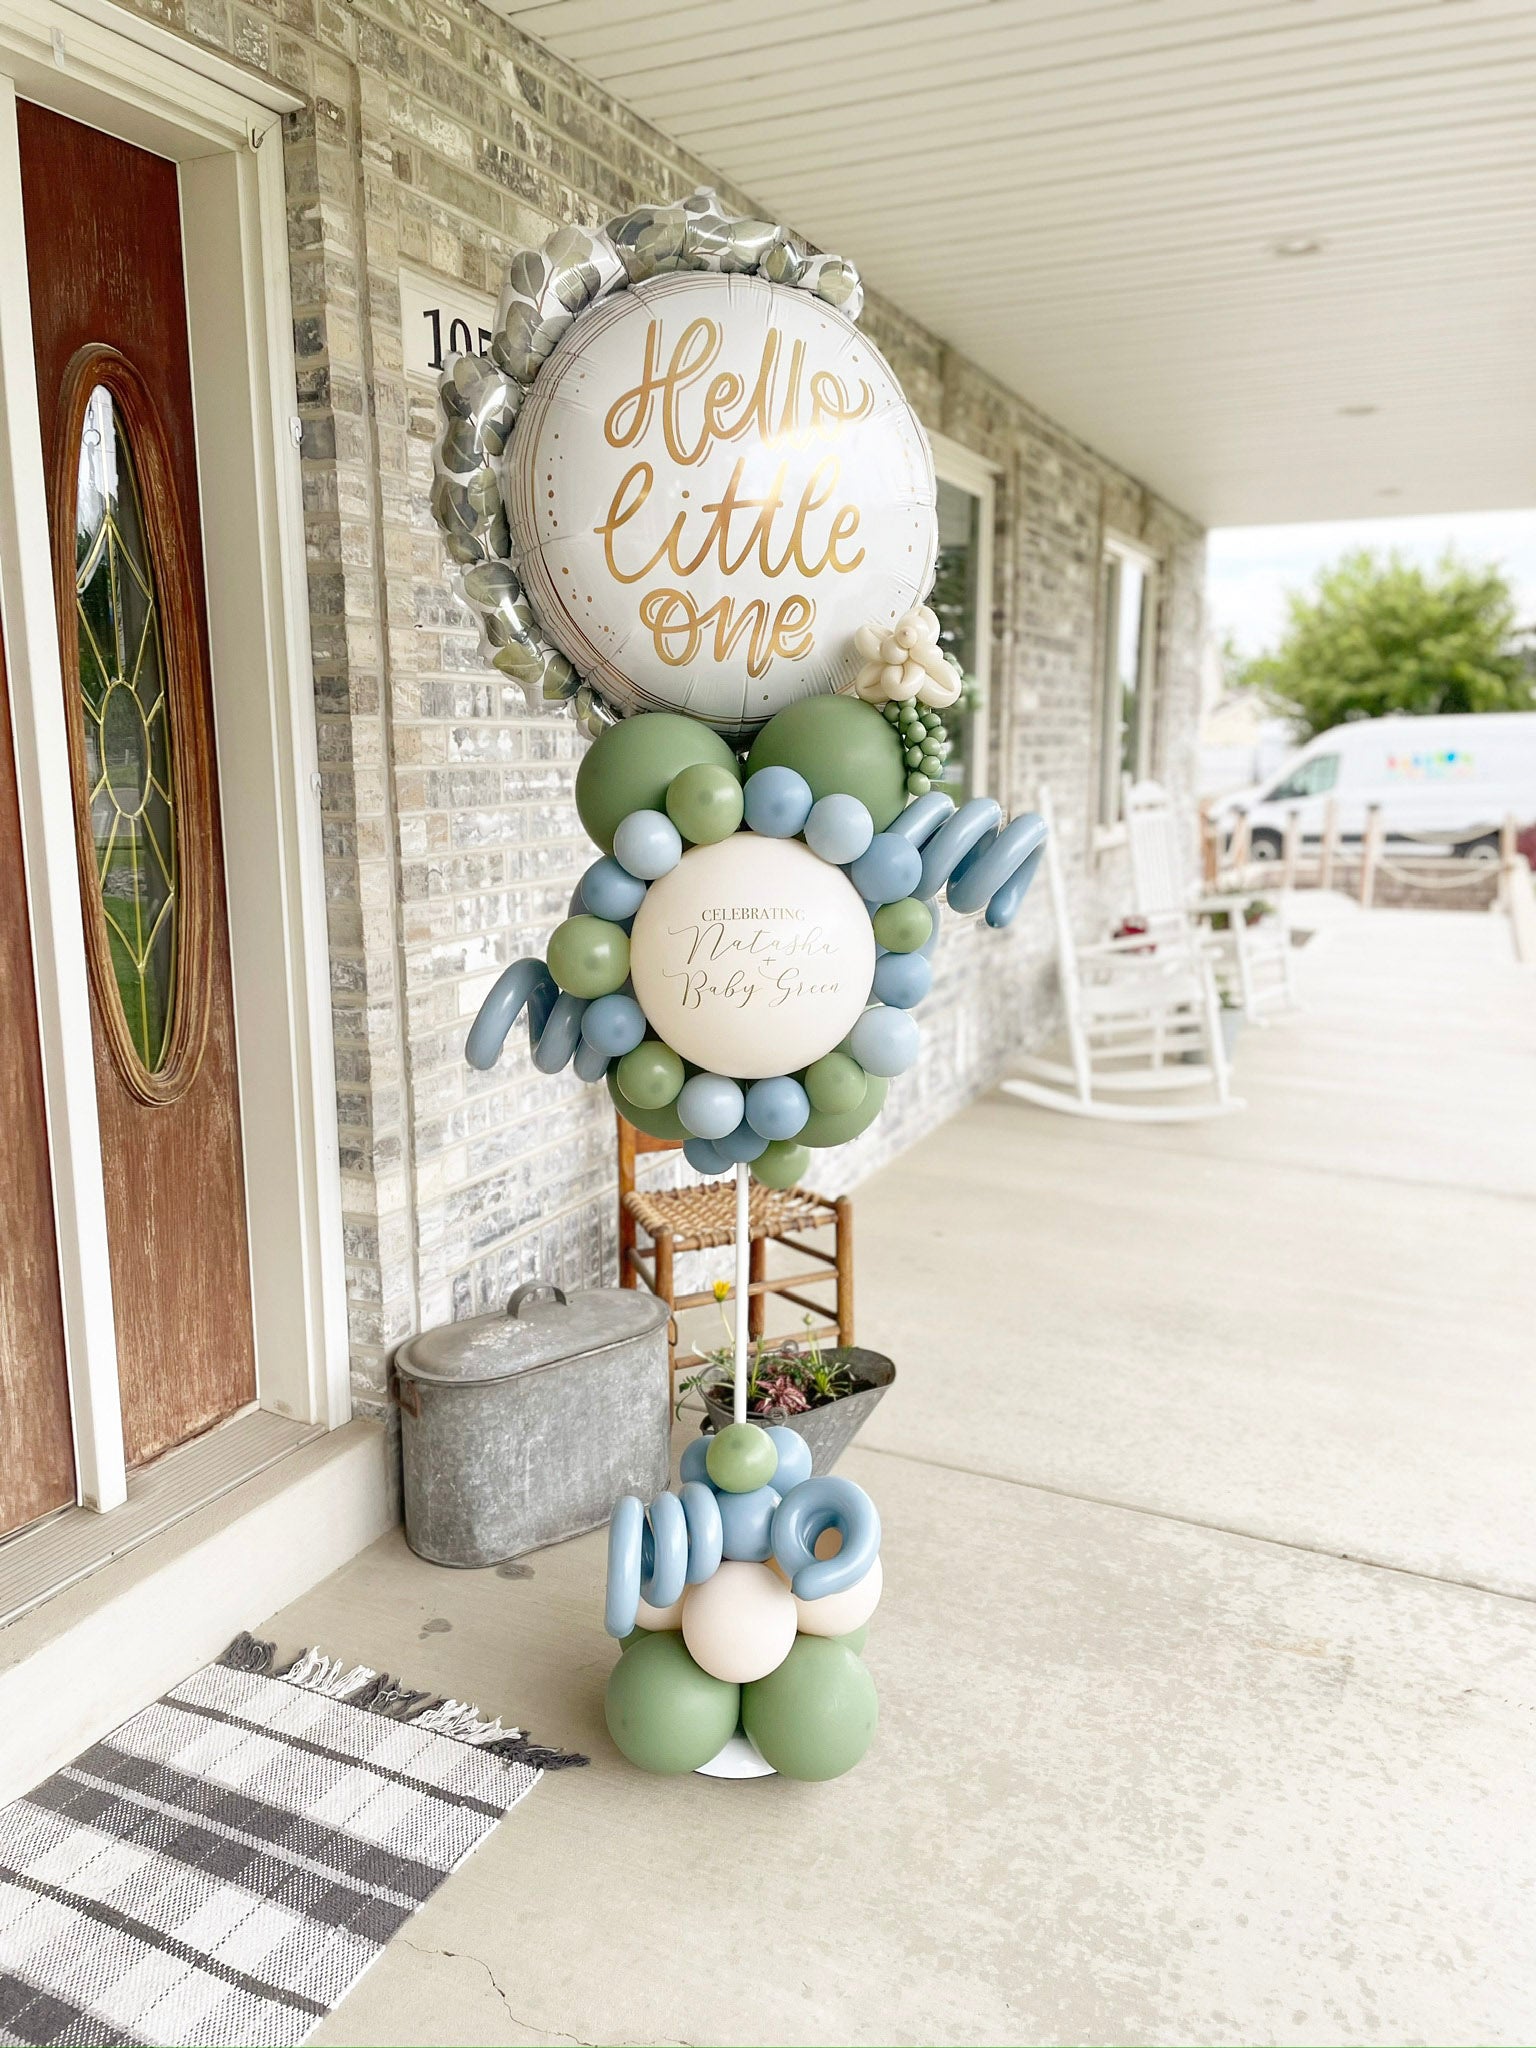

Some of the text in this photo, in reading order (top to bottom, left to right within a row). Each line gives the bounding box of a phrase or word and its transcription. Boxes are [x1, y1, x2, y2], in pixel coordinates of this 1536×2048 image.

[604, 317, 875, 467] Hello
[639, 588, 816, 679] one
[702, 907, 806, 922] CELEBRATING
[668, 922, 840, 964] Natasha
[662, 966, 842, 1009] Baby Green
